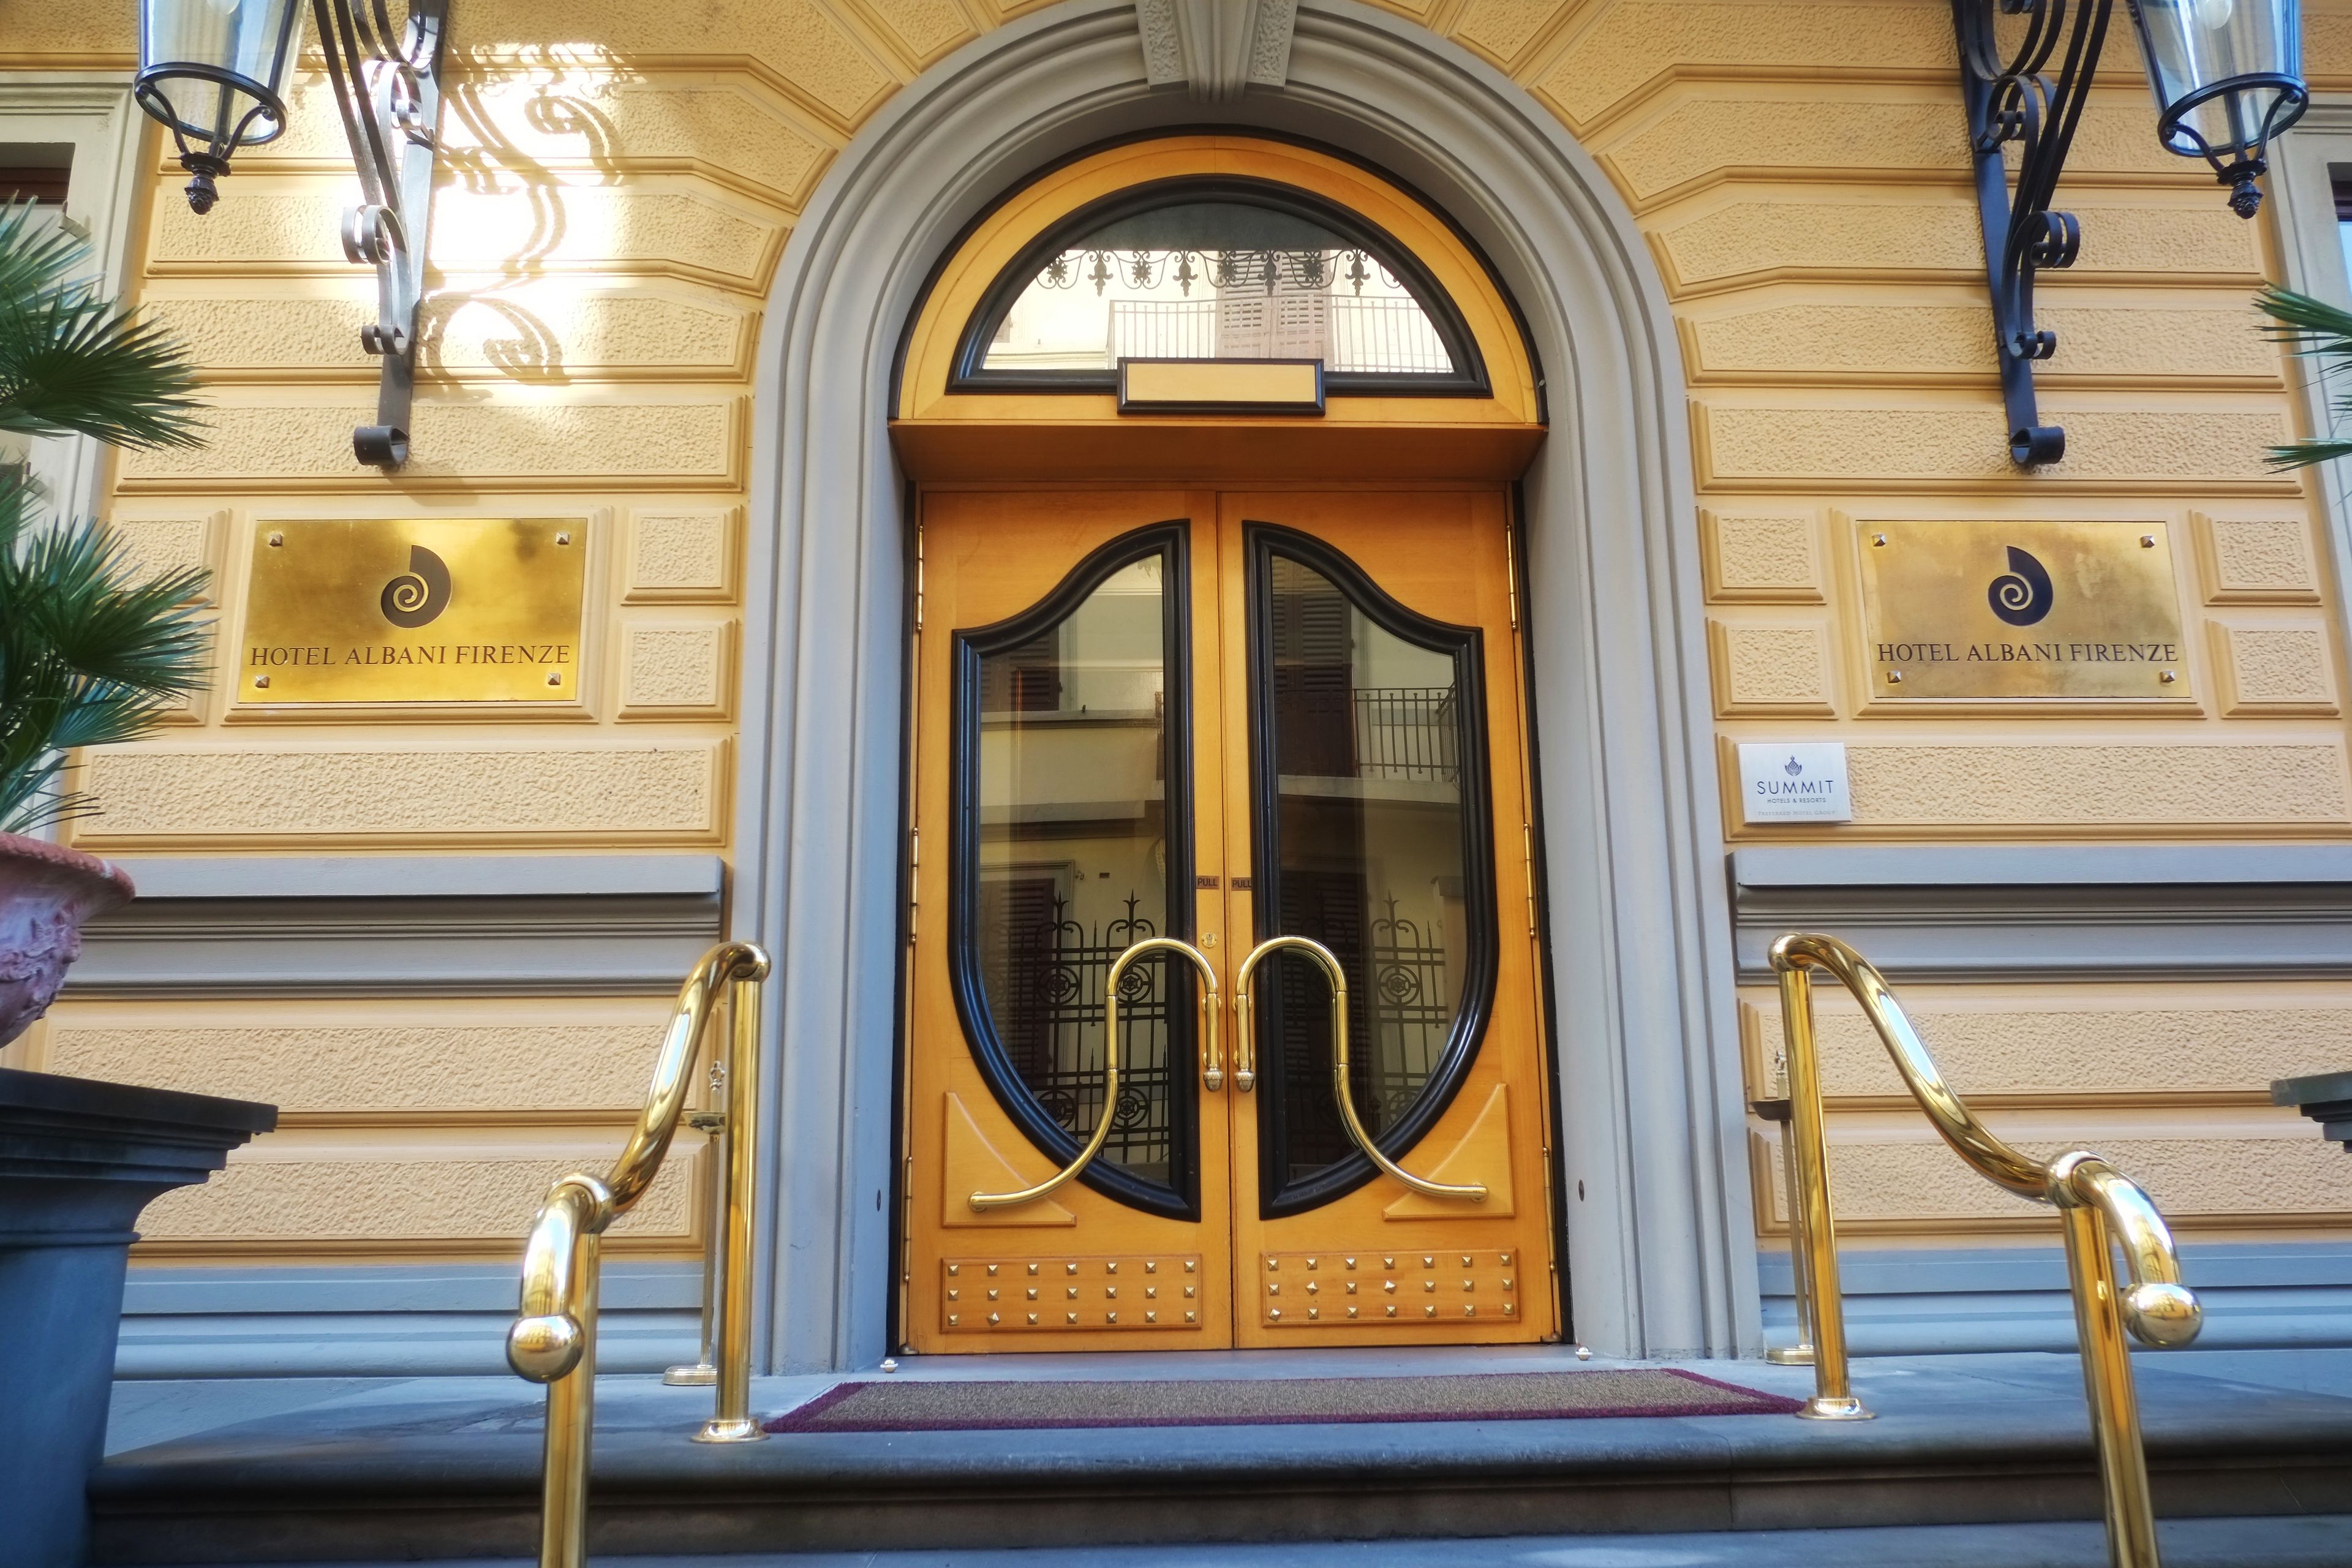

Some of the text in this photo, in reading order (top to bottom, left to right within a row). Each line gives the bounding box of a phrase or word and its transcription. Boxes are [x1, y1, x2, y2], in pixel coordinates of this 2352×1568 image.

[250, 645, 570, 666] HOTEL ALBANI FIRENZE
[1877, 644, 2178, 662] HOTEL ALBANI FIRENZE
[1757, 780, 1834, 794] SUMMIT
[1197, 878, 1218, 886] PULL
[1232, 880, 1252, 888] PULL
